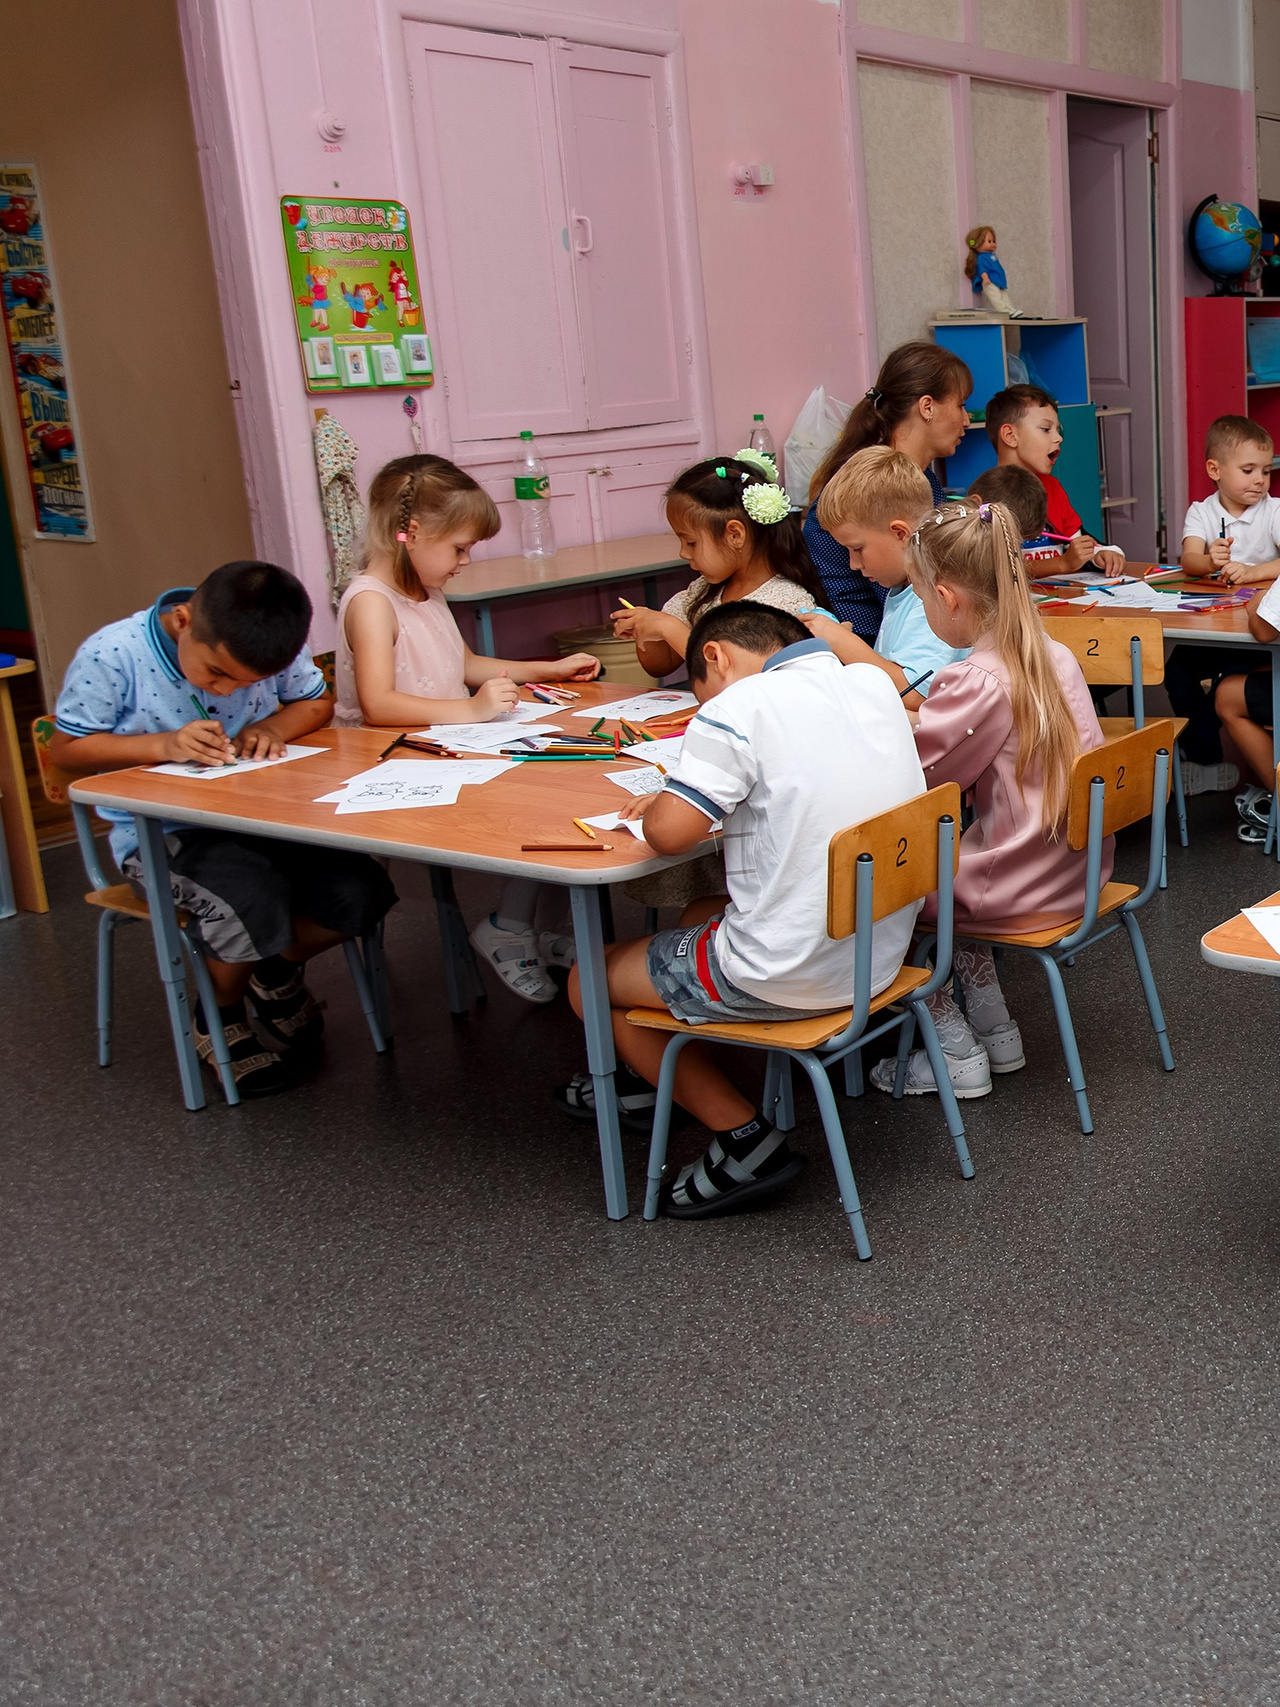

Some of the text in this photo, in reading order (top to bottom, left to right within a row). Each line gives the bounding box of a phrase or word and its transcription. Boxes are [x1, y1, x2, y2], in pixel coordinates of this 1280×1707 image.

[305, 204, 389, 229] УГОЛОК
[295, 230, 409, 253] ДЕЖУРСТВ
[1086, 638, 1100, 656] 2
[1116, 765, 1126, 790] 2
[895, 837, 908, 867] 2
[733, 1123, 758, 1138] Lee
